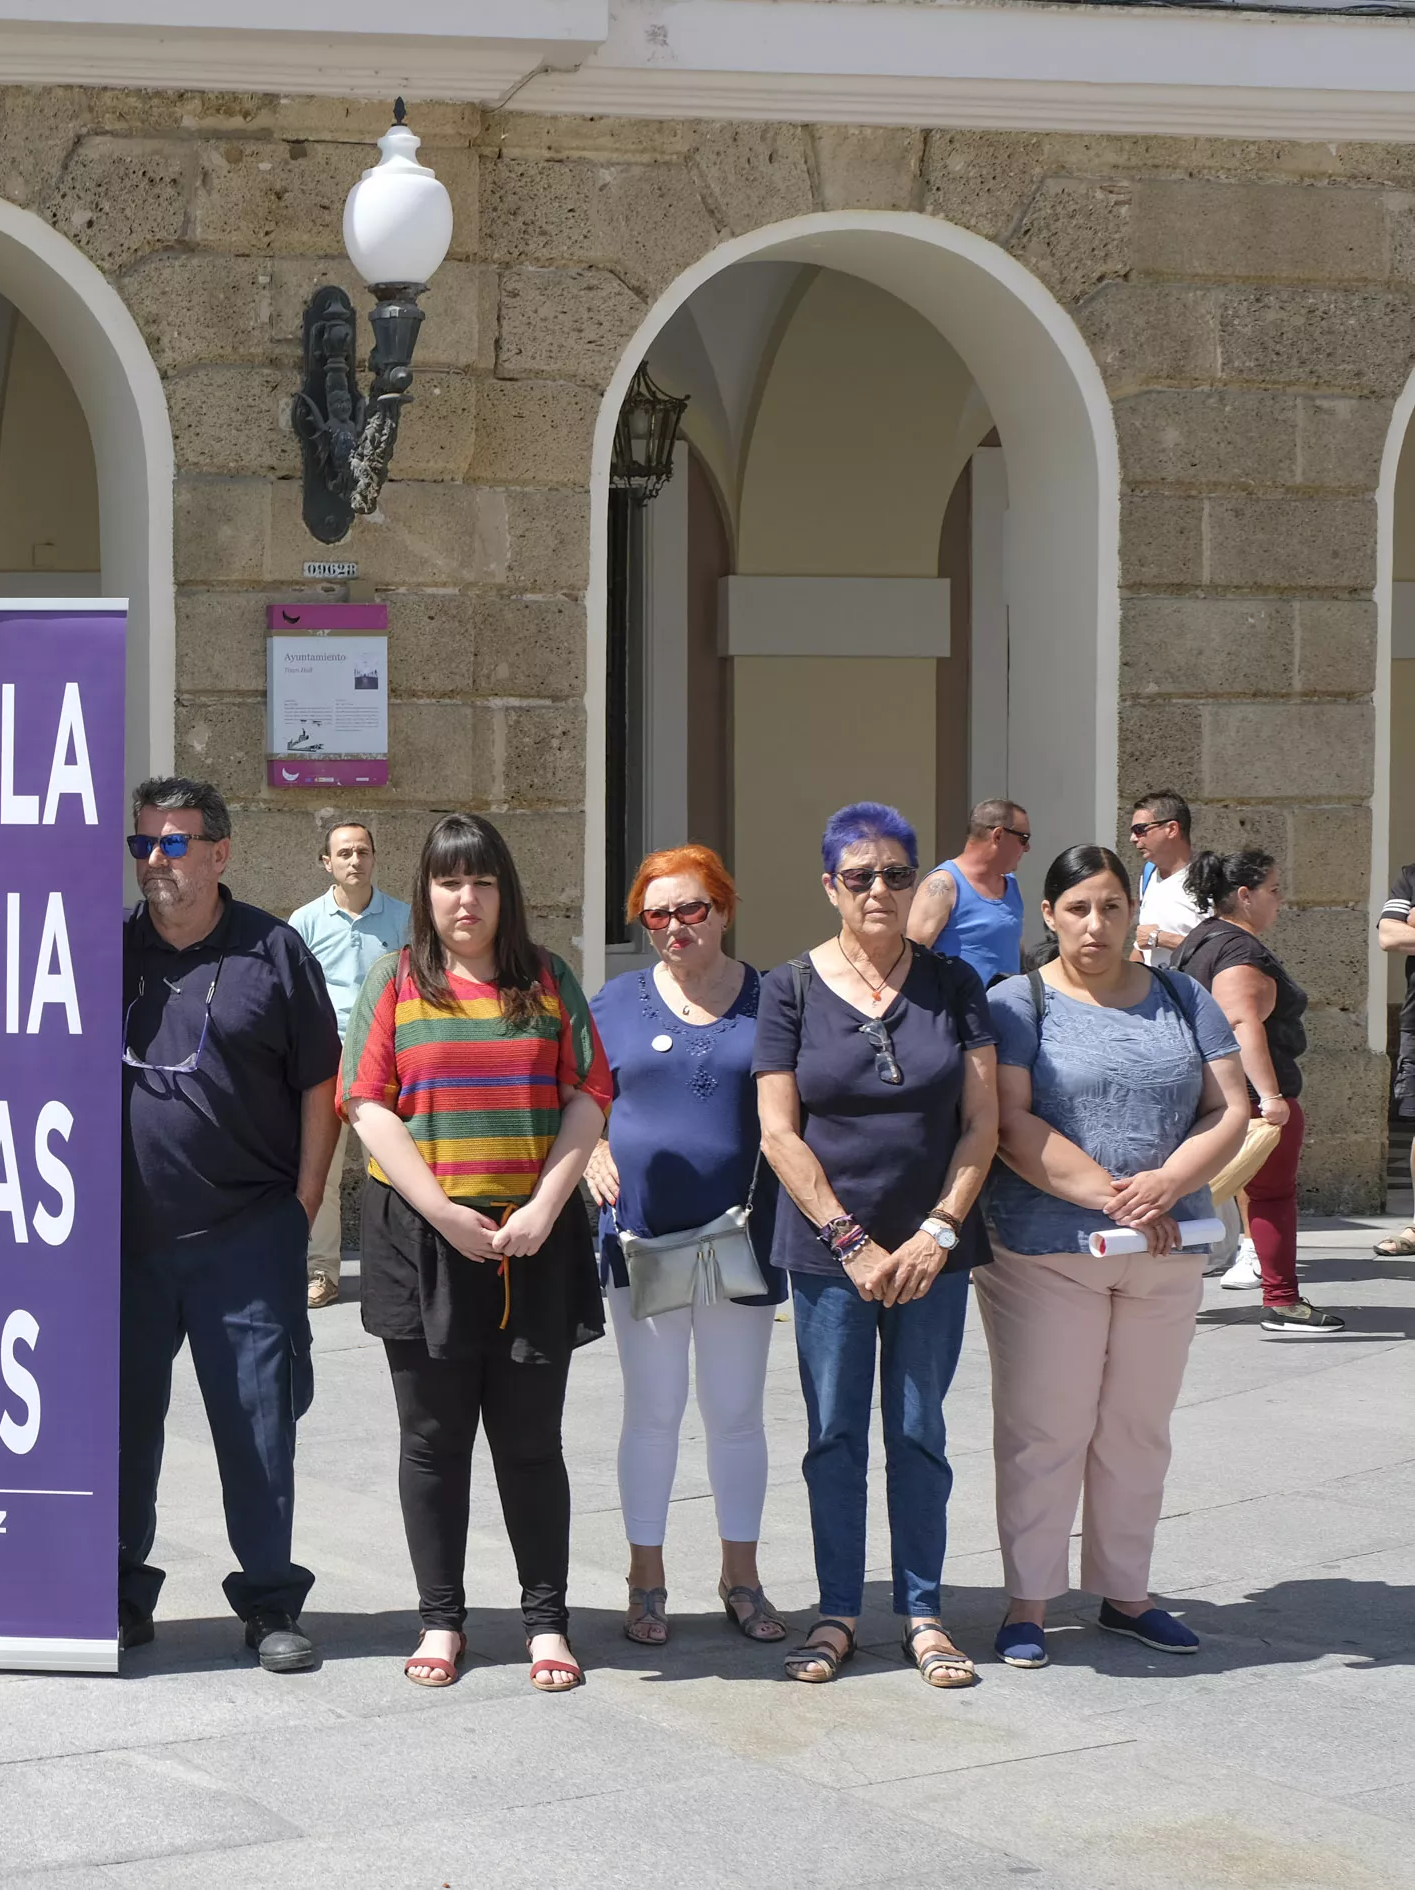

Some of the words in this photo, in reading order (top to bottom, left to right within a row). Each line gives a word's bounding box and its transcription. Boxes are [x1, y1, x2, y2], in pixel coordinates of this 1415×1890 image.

[307, 563, 355, 576] 09628
[284, 652, 347, 664] Ayuntamiento
[0, 682, 99, 825] LA
